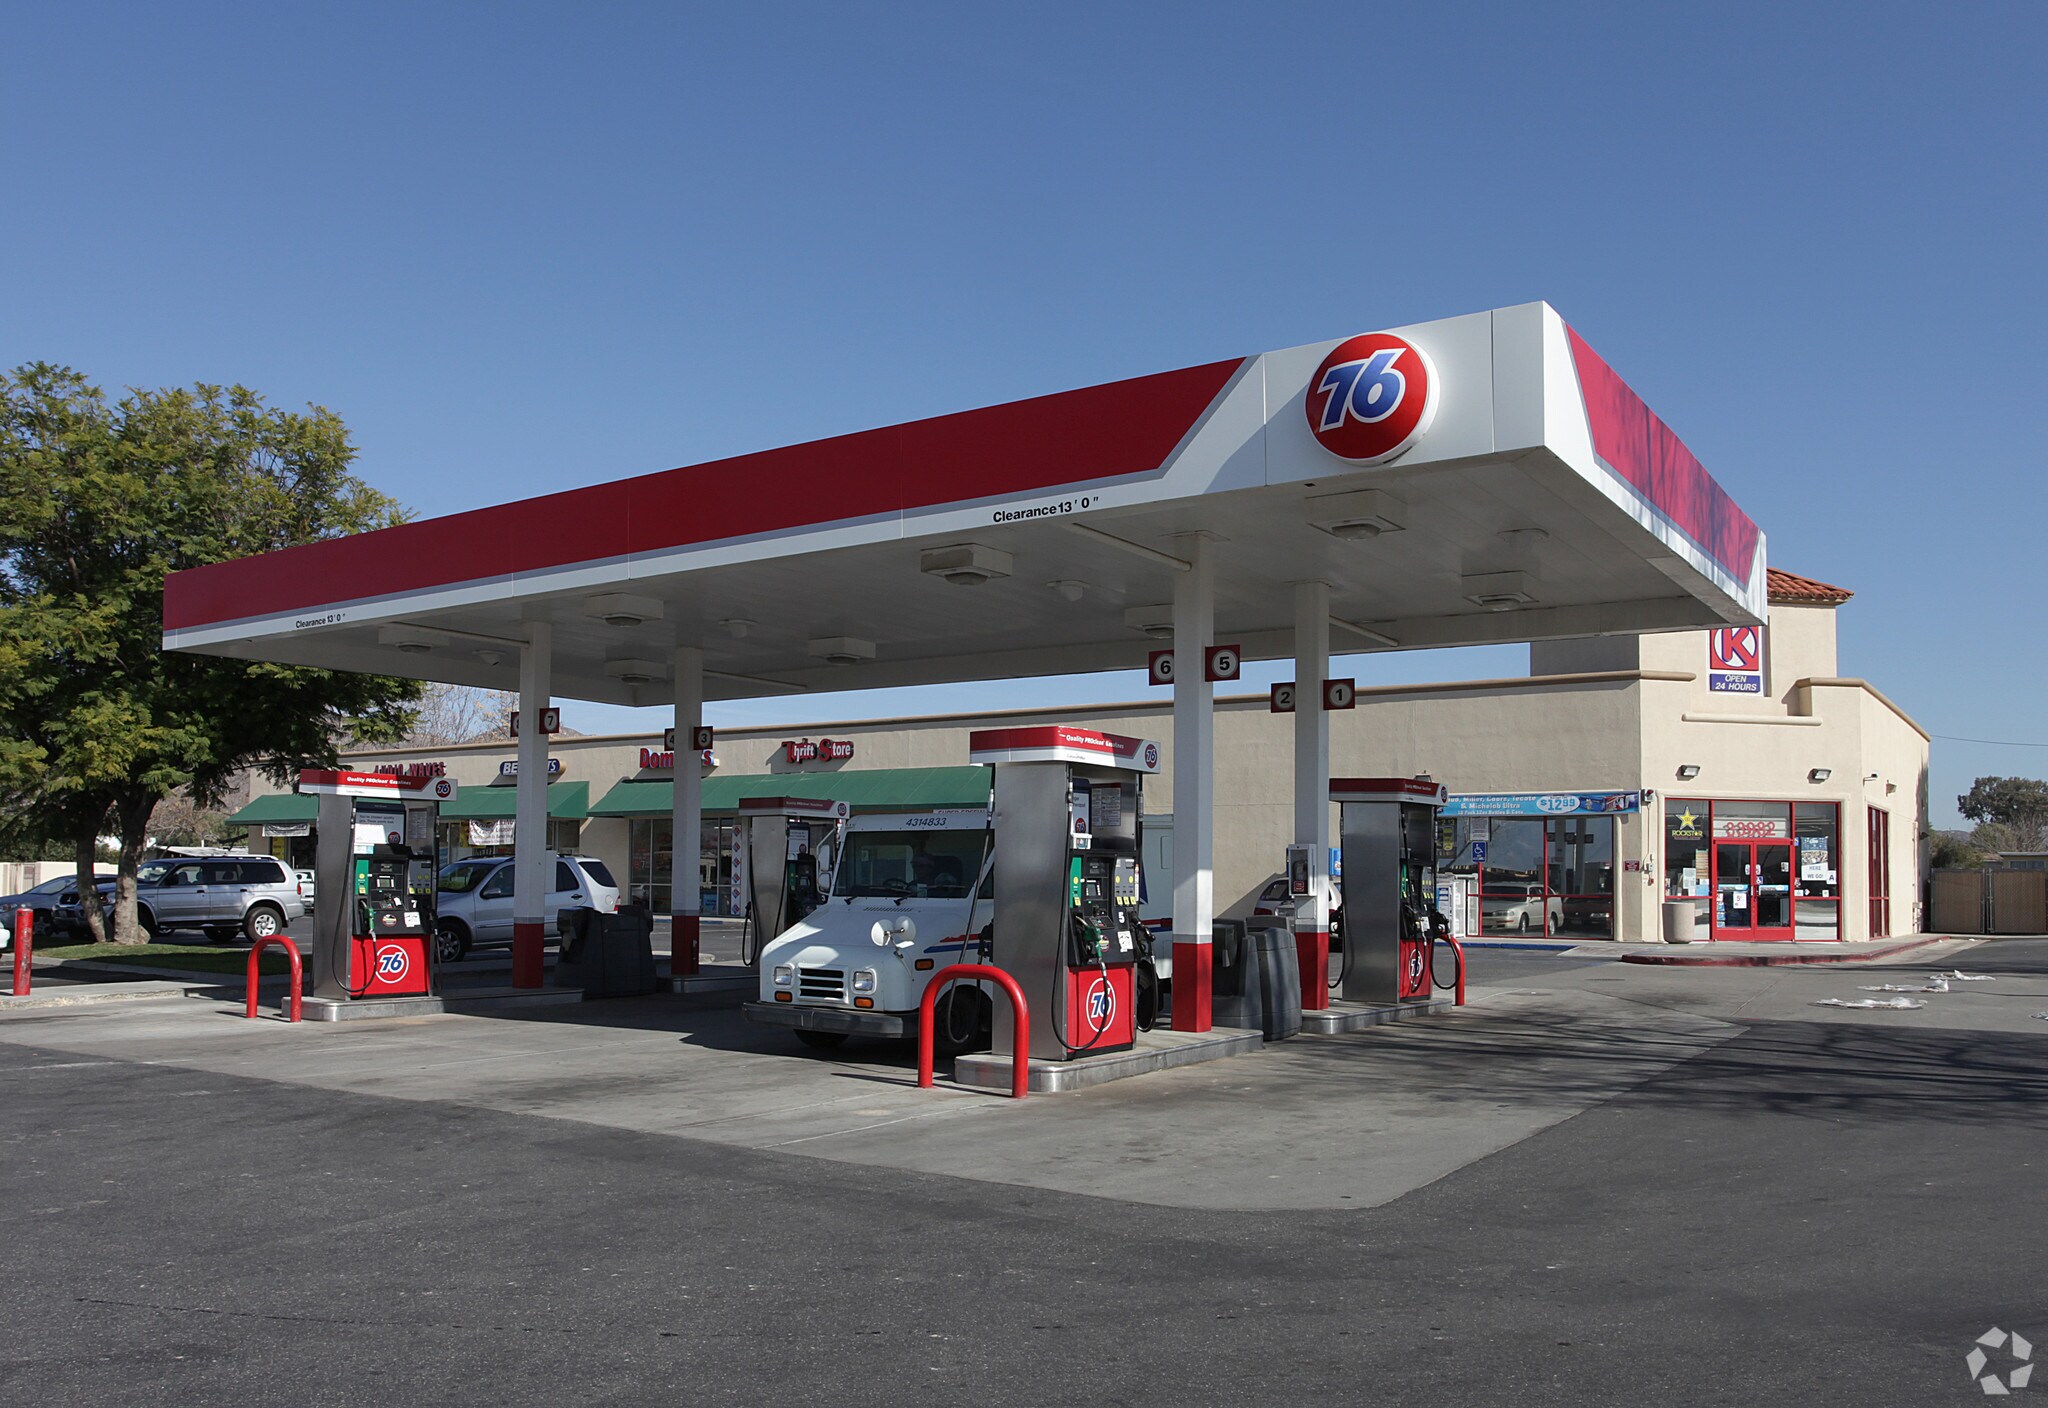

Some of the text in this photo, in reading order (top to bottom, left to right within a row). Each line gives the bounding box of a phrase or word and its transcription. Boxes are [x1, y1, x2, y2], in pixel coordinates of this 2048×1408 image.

[1317, 347, 1408, 433] 76
[993, 505, 1057, 523] Clearance
[295, 617, 326, 628] Clearance
[1721, 625, 1755, 665] K
[1160, 660, 1171, 675] 6
[1219, 656, 1230, 671] 5
[1725, 674, 1747, 683] OPEN
[1715, 682, 1757, 691] 24 HOURS
[1280, 691, 1290, 704] 2
[1335, 688, 1343, 701] 1
[548, 715, 554, 727] 7
[700, 733, 708, 743] 3
[1066, 734, 1084, 744] Quality
[781, 738, 853, 764] Thrift Store
[1146, 749, 1156, 763] 76
[409, 762, 447, 777] WAVES
[437, 784, 449, 793] 76
[906, 817, 947, 827] 4314833
[1118, 911, 1125, 923] 5
[379, 951, 404, 974] 76
[1091, 987, 1112, 1019] 76
